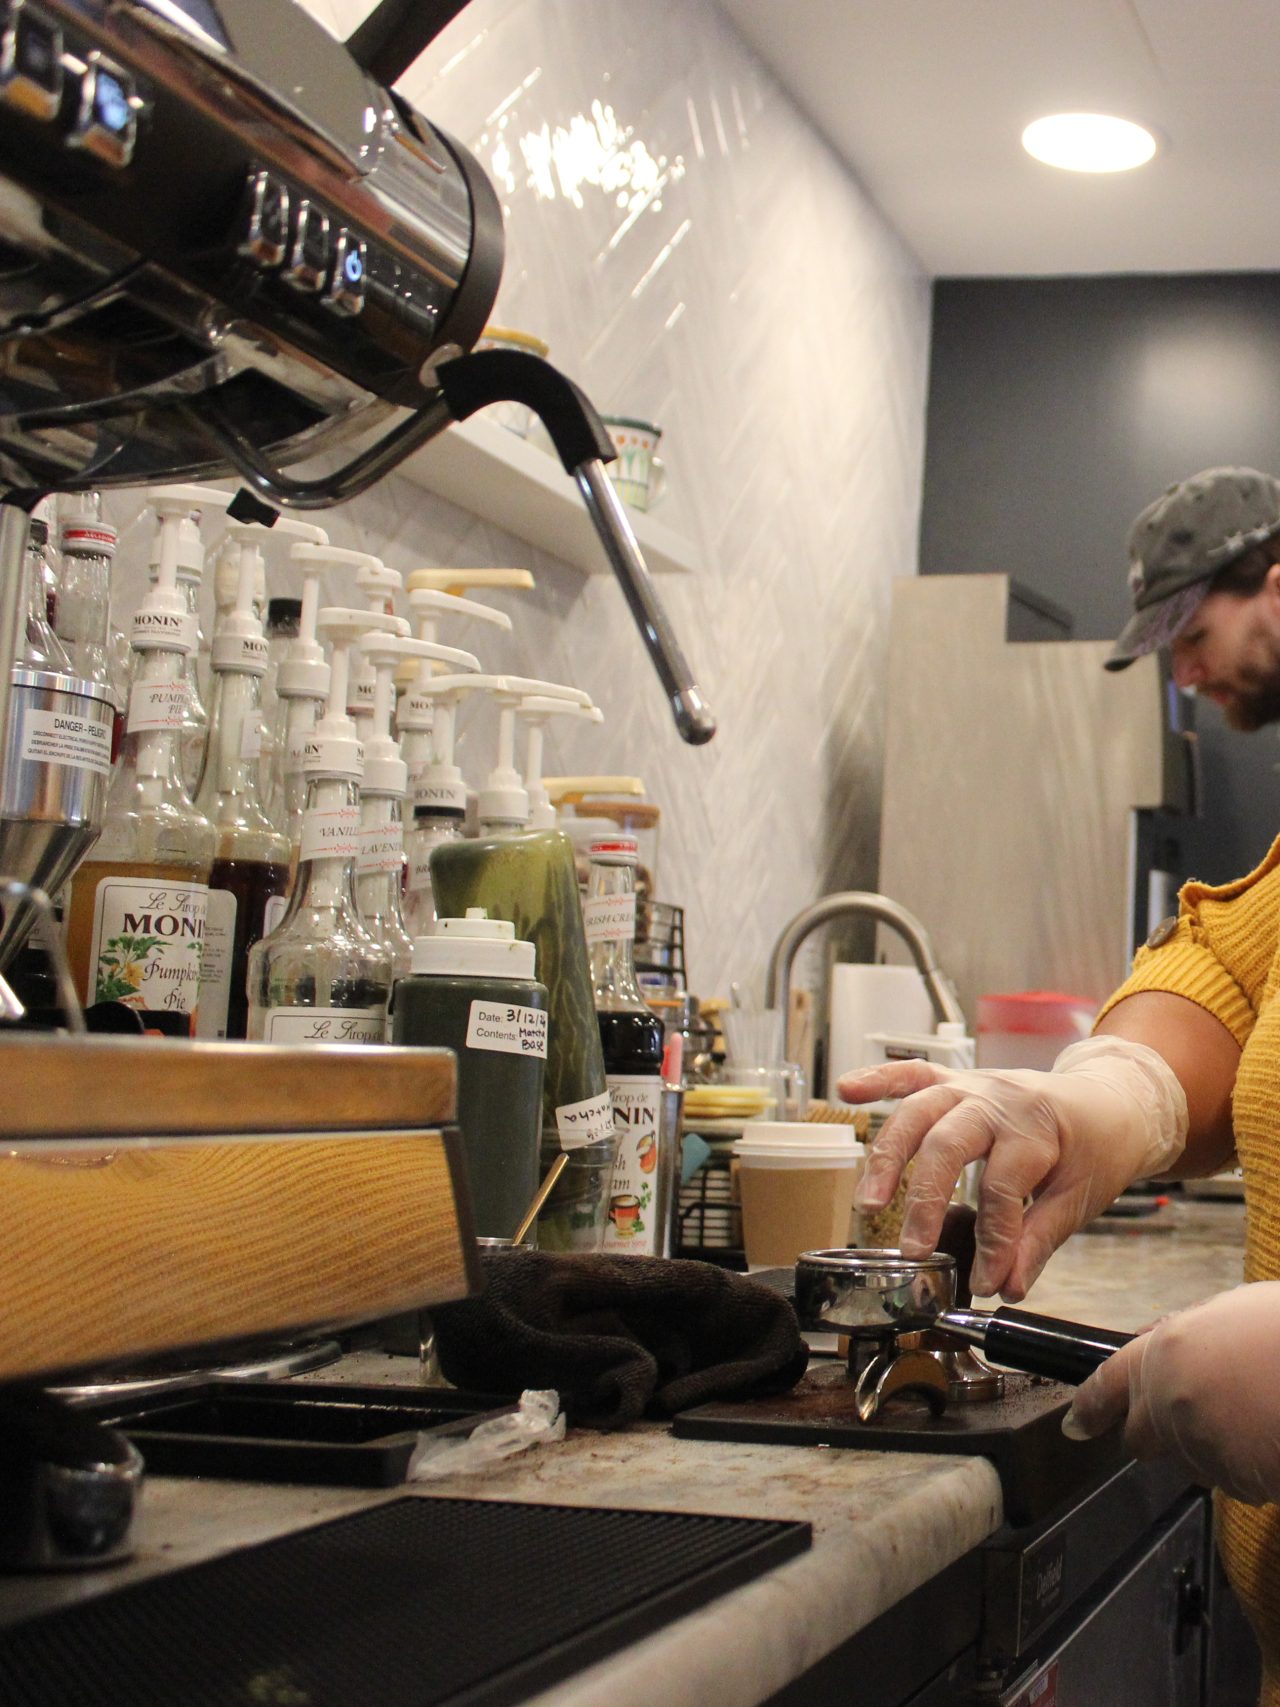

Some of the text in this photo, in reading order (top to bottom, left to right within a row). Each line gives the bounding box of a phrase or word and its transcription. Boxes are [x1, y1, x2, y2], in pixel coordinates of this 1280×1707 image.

[134, 615, 179, 627] MONIN
[54, 718, 84, 733] DANGER
[139, 892, 167, 910] Le
[163, 987, 186, 1010] Pie
[478, 1011, 502, 1023] Date:
[304, 1020, 331, 1040] Le
[334, 1020, 371, 1044] Sirop
[476, 1027, 517, 1041] Contents:
[636, 1092, 650, 1102] de
[613, 1107, 655, 1125] NIN
